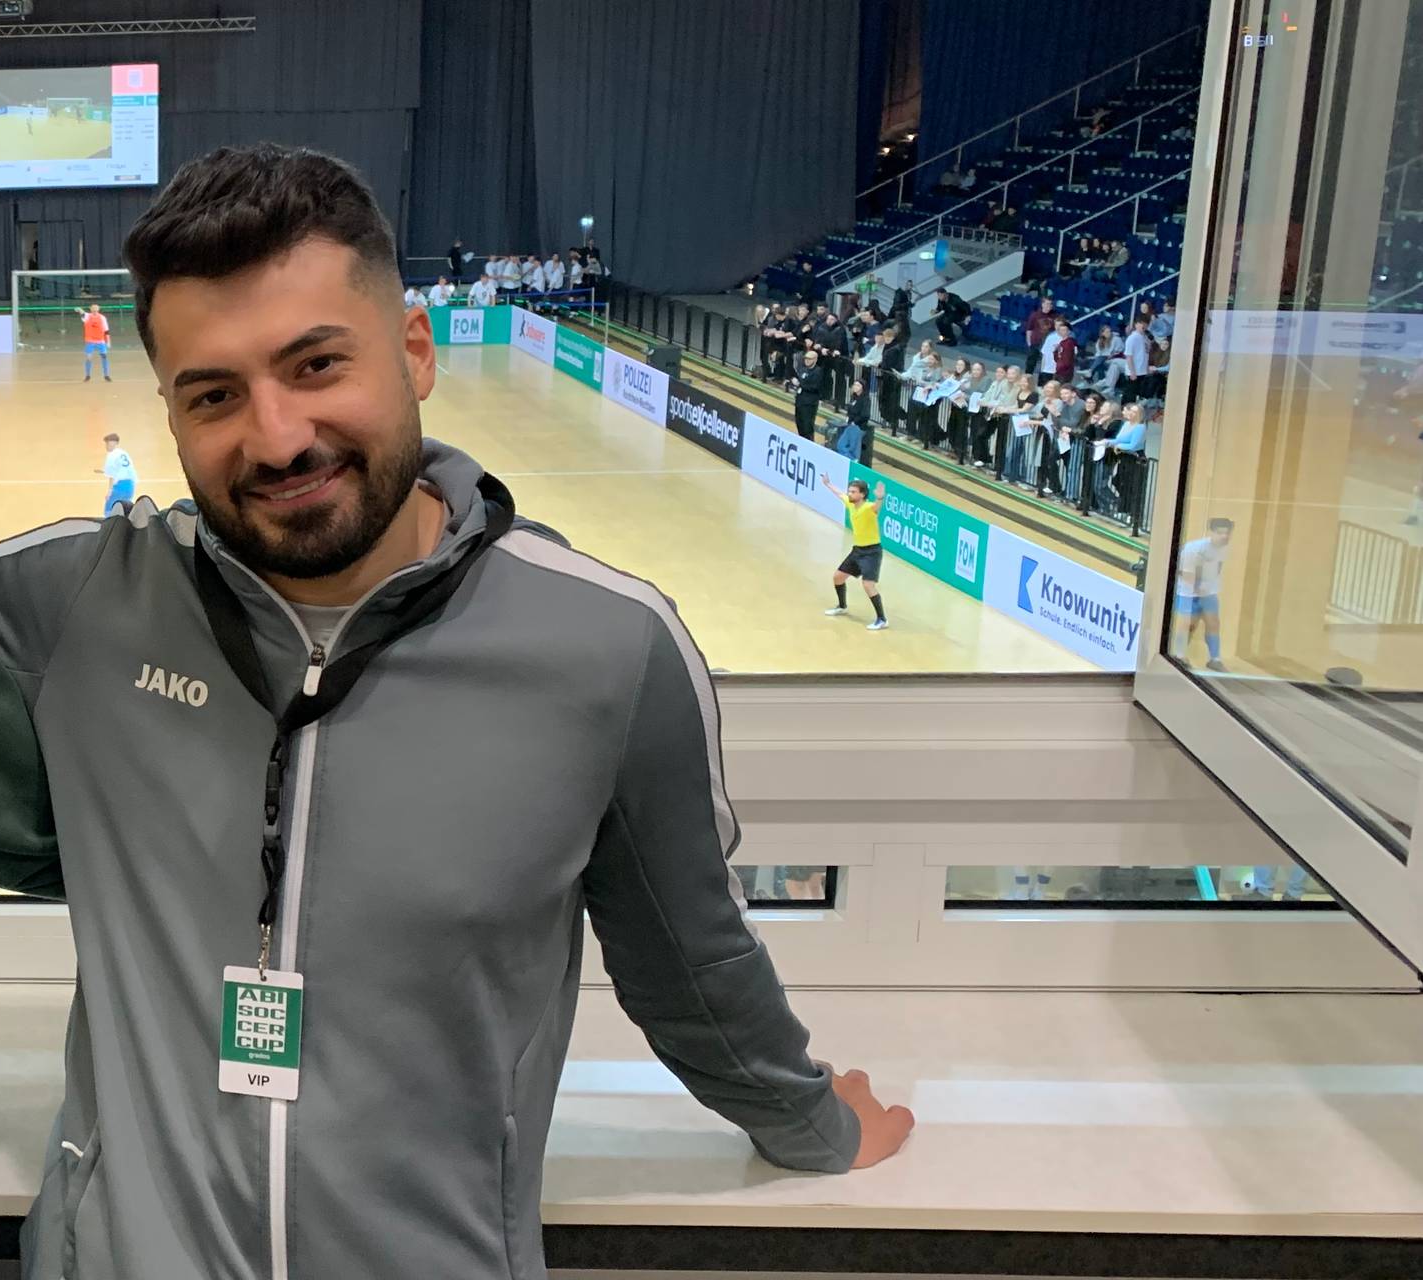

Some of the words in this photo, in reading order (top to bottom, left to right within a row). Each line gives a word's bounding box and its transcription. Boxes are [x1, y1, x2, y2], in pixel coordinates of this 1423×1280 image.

[453, 317, 480, 336] FOM
[623, 364, 652, 396] POLIZEI
[120, 454, 130, 468] 3
[885, 494, 899, 515] GIB
[899, 501, 915, 521] AUF
[914, 507, 938, 534] ODER
[883, 515, 902, 544] GIB
[901, 526, 937, 562] ALLES
[957, 540, 976, 570] FOM
[1041, 573, 1139, 652] Knowunity
[1063, 618, 1088, 639] Endlich
[135, 663, 208, 707] JAKO
[239, 988, 284, 1005] ABI
[238, 1005, 285, 1021] SOC
[237, 1020, 284, 1036] CER
[237, 1036, 284, 1051] CUP
[247, 1073, 270, 1087] VIP
